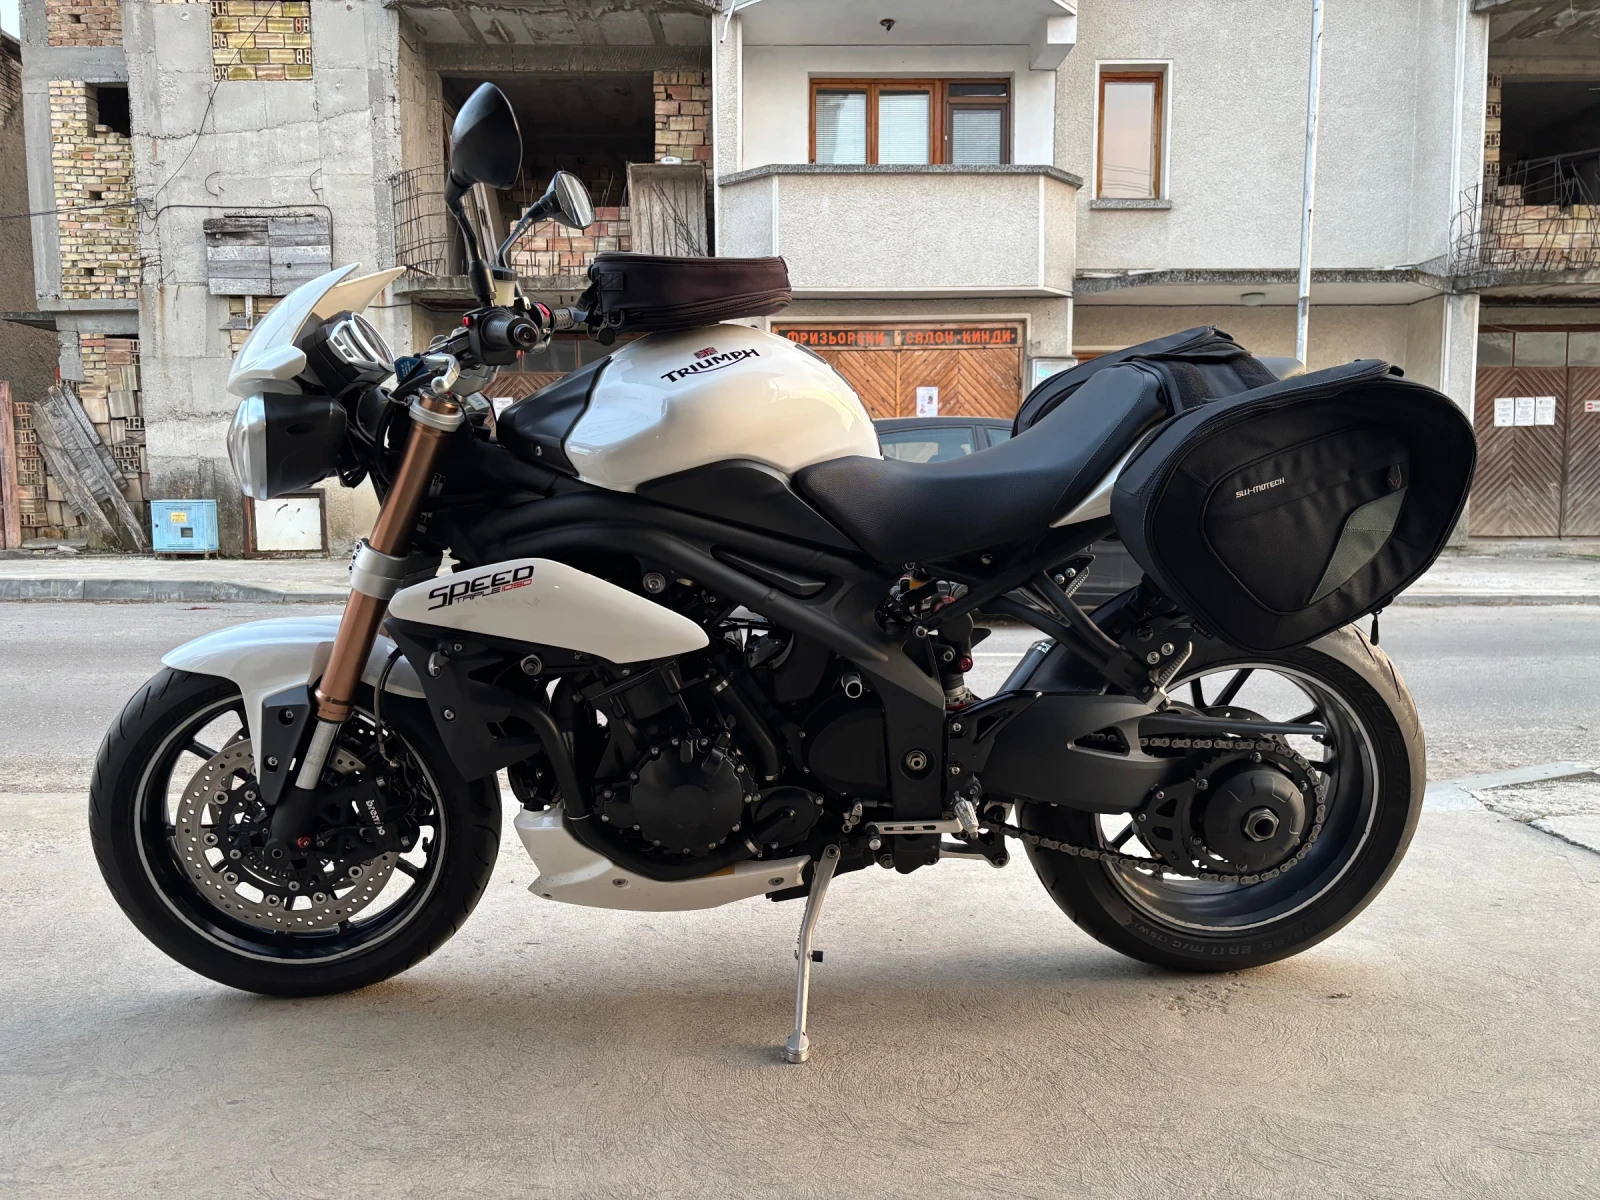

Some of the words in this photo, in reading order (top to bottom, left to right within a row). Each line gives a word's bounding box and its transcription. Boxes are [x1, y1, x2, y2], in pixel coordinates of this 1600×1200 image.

[787, 330, 885, 346] ФРИЗЬОРСКИ
[905, 329, 957, 345] САЛОН
[660, 348, 760, 383] TRIUMPH
[427, 565, 534, 611] SPEED
